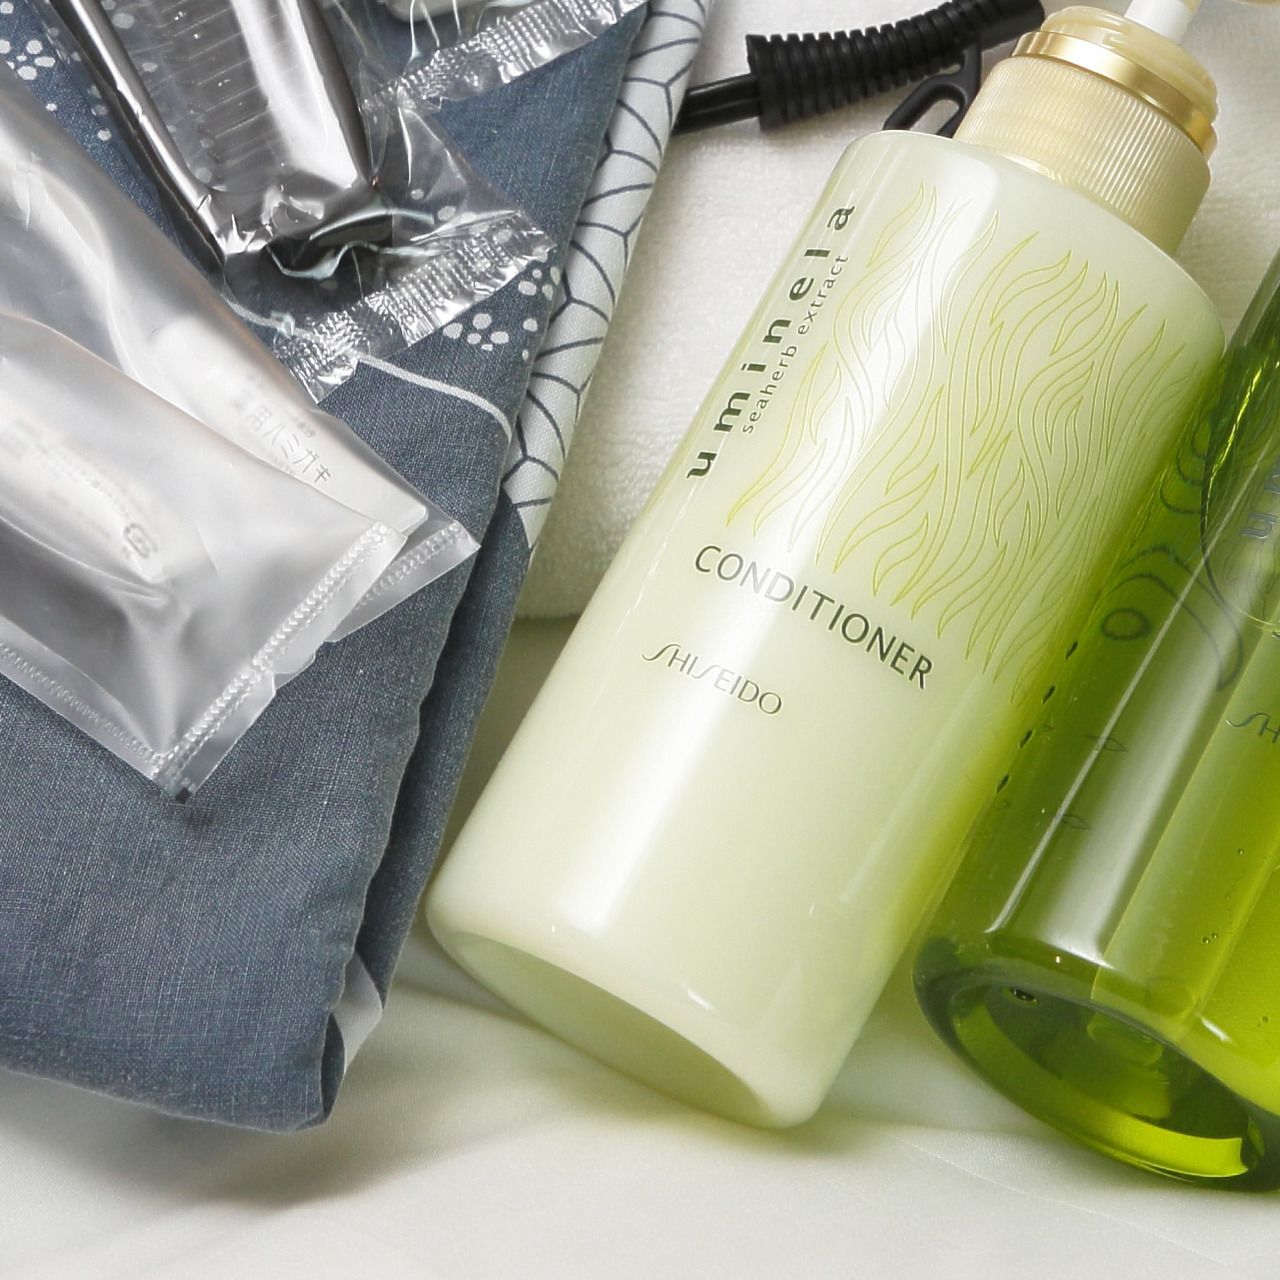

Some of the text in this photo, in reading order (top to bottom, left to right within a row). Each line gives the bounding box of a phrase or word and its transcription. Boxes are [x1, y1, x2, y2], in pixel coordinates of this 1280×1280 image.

[686, 204, 857, 480] uminela
[741, 254, 849, 435] seaherb extract
[641, 642, 783, 717] SHISEIDO
[694, 544, 934, 690] CONDITIONER
